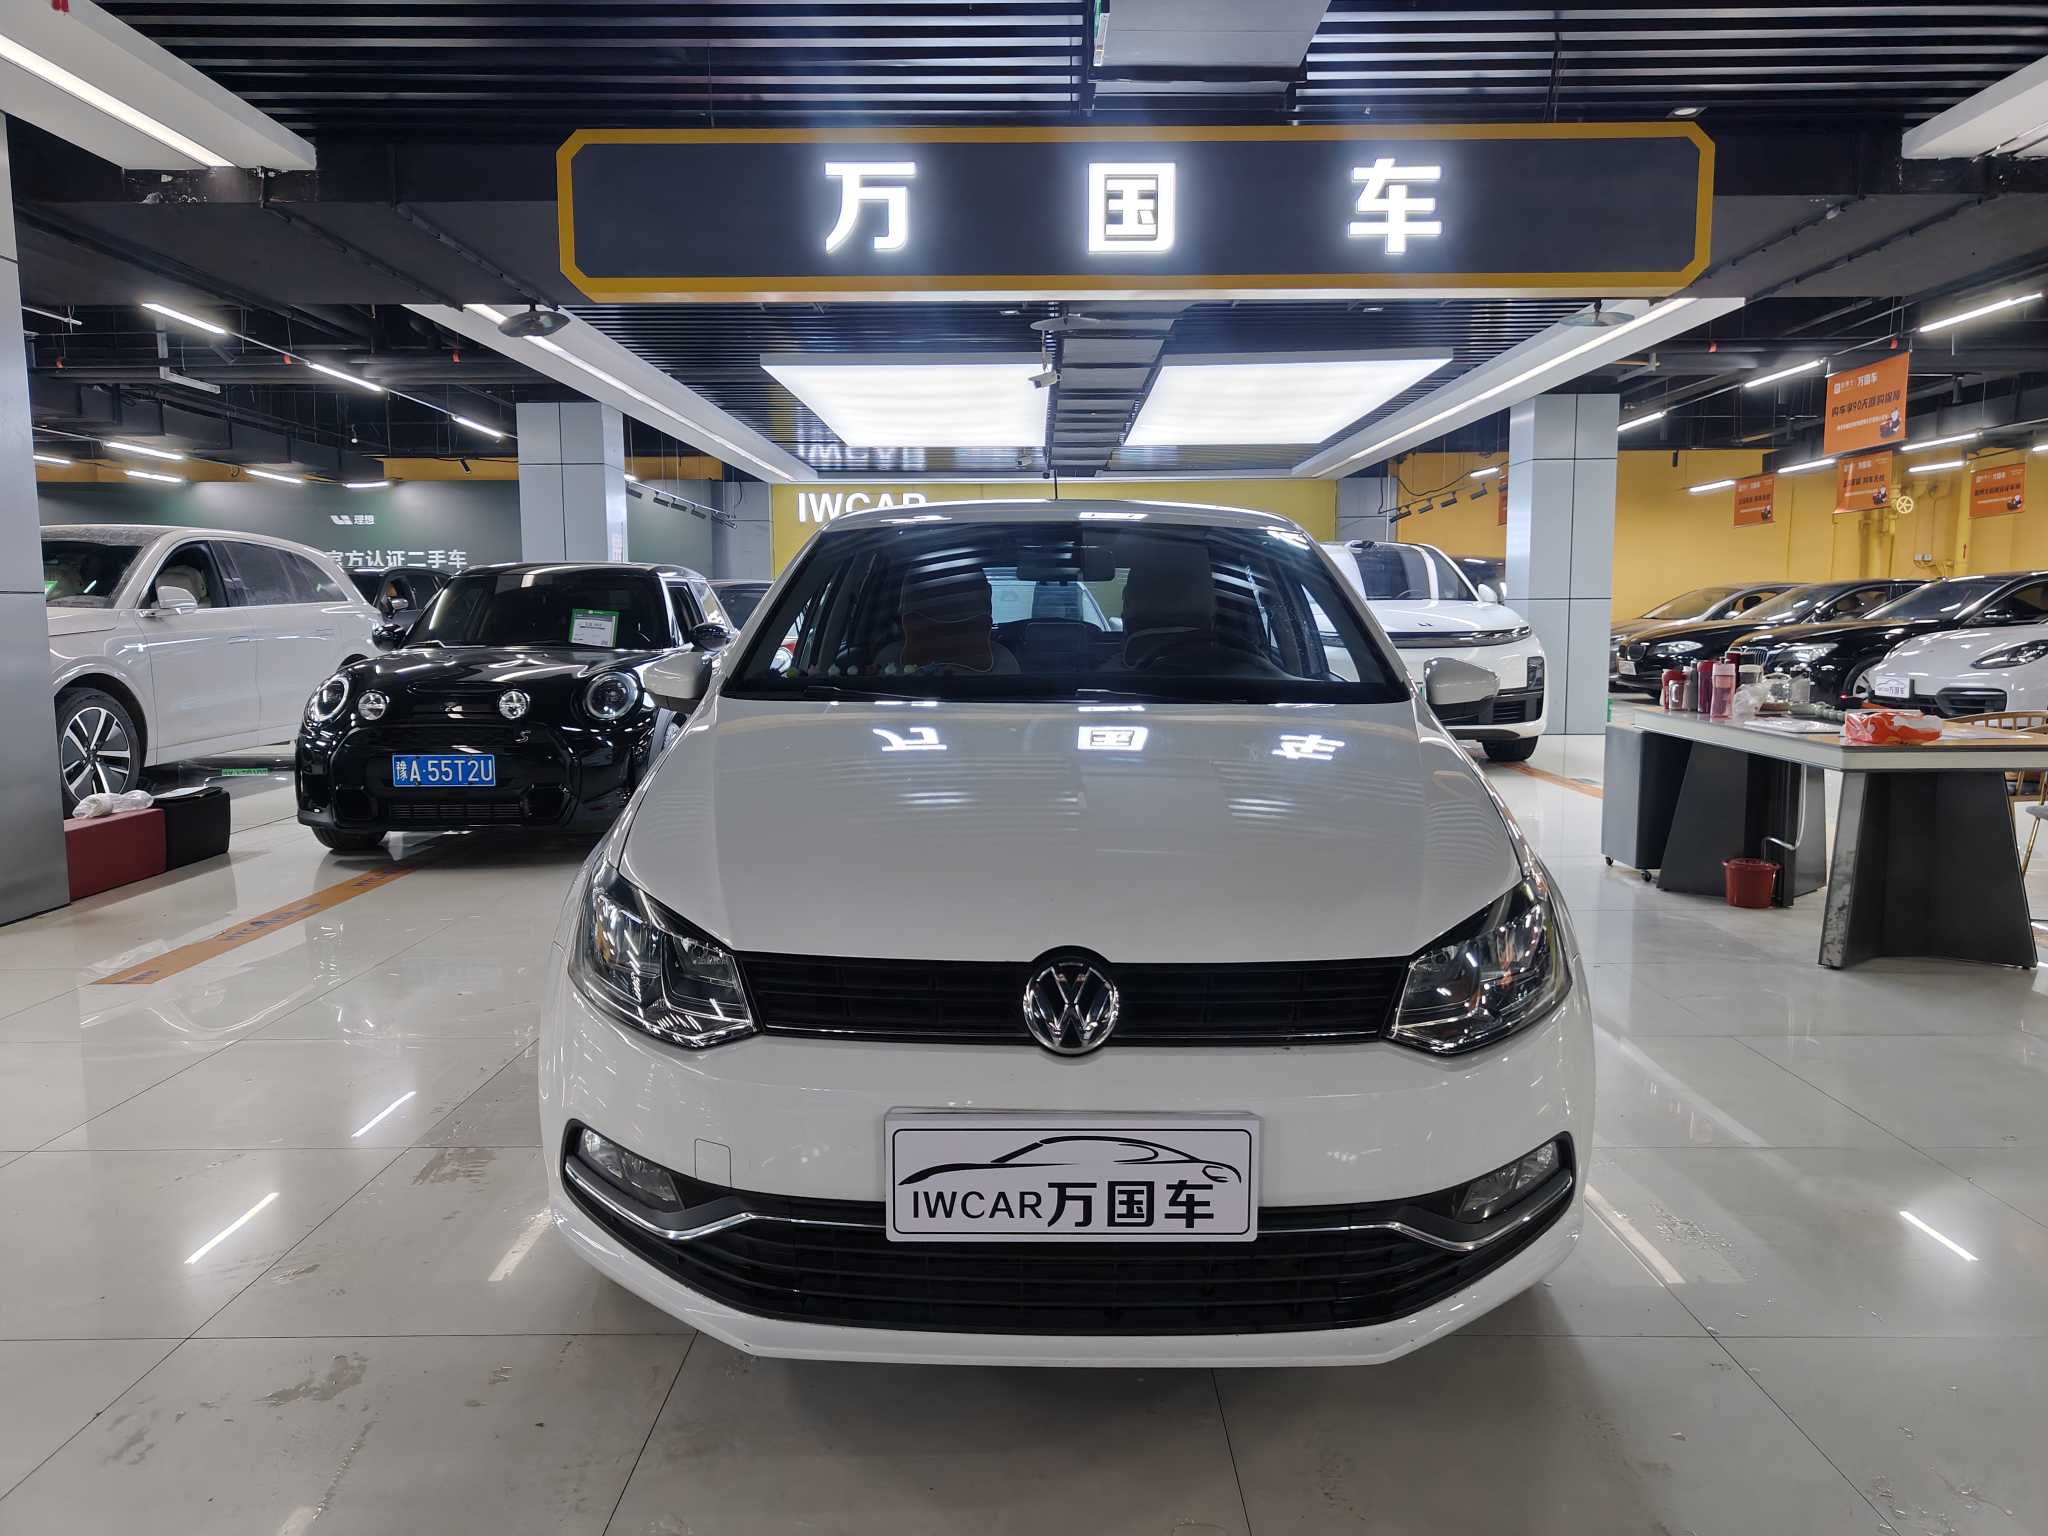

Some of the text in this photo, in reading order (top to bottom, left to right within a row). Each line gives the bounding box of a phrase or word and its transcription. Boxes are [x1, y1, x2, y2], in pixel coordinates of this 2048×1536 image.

[824, 157, 1443, 255] 万国车
[327, 549, 468, 569] 官方认证二手车
